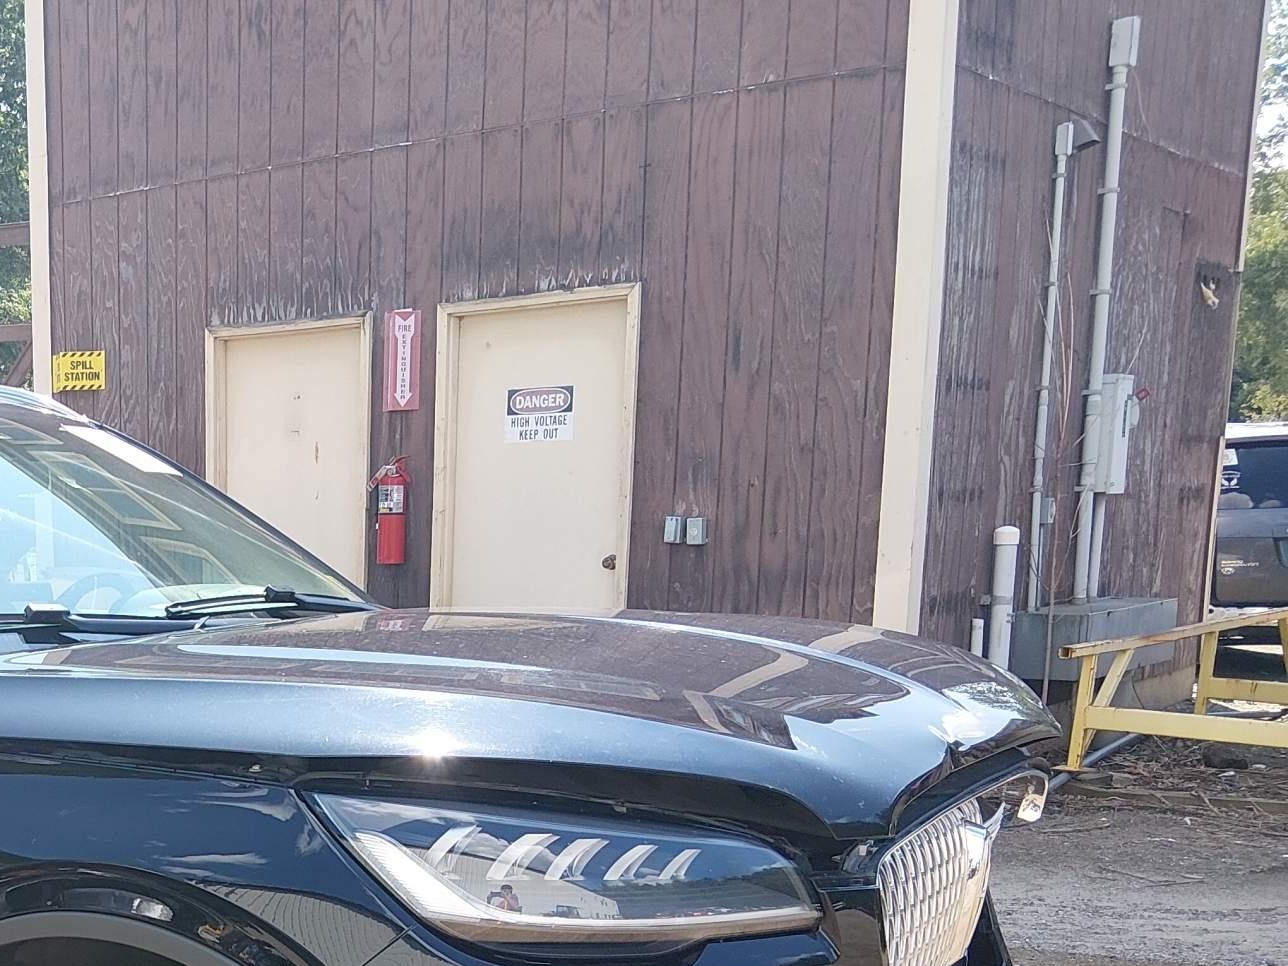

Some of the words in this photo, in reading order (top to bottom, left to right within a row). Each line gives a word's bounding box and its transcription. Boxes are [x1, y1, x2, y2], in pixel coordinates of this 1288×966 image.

[397, 324, 412, 333] FIRE
[70, 360, 94, 370] SPILL
[64, 371, 100, 382] STATION
[515, 393, 565, 409] DANGER
[511, 416, 530, 428] HIGH
[534, 415, 568, 427] VOLTAGE
[519, 429, 539, 441] KEEP
[543, 428, 559, 440] OUT
